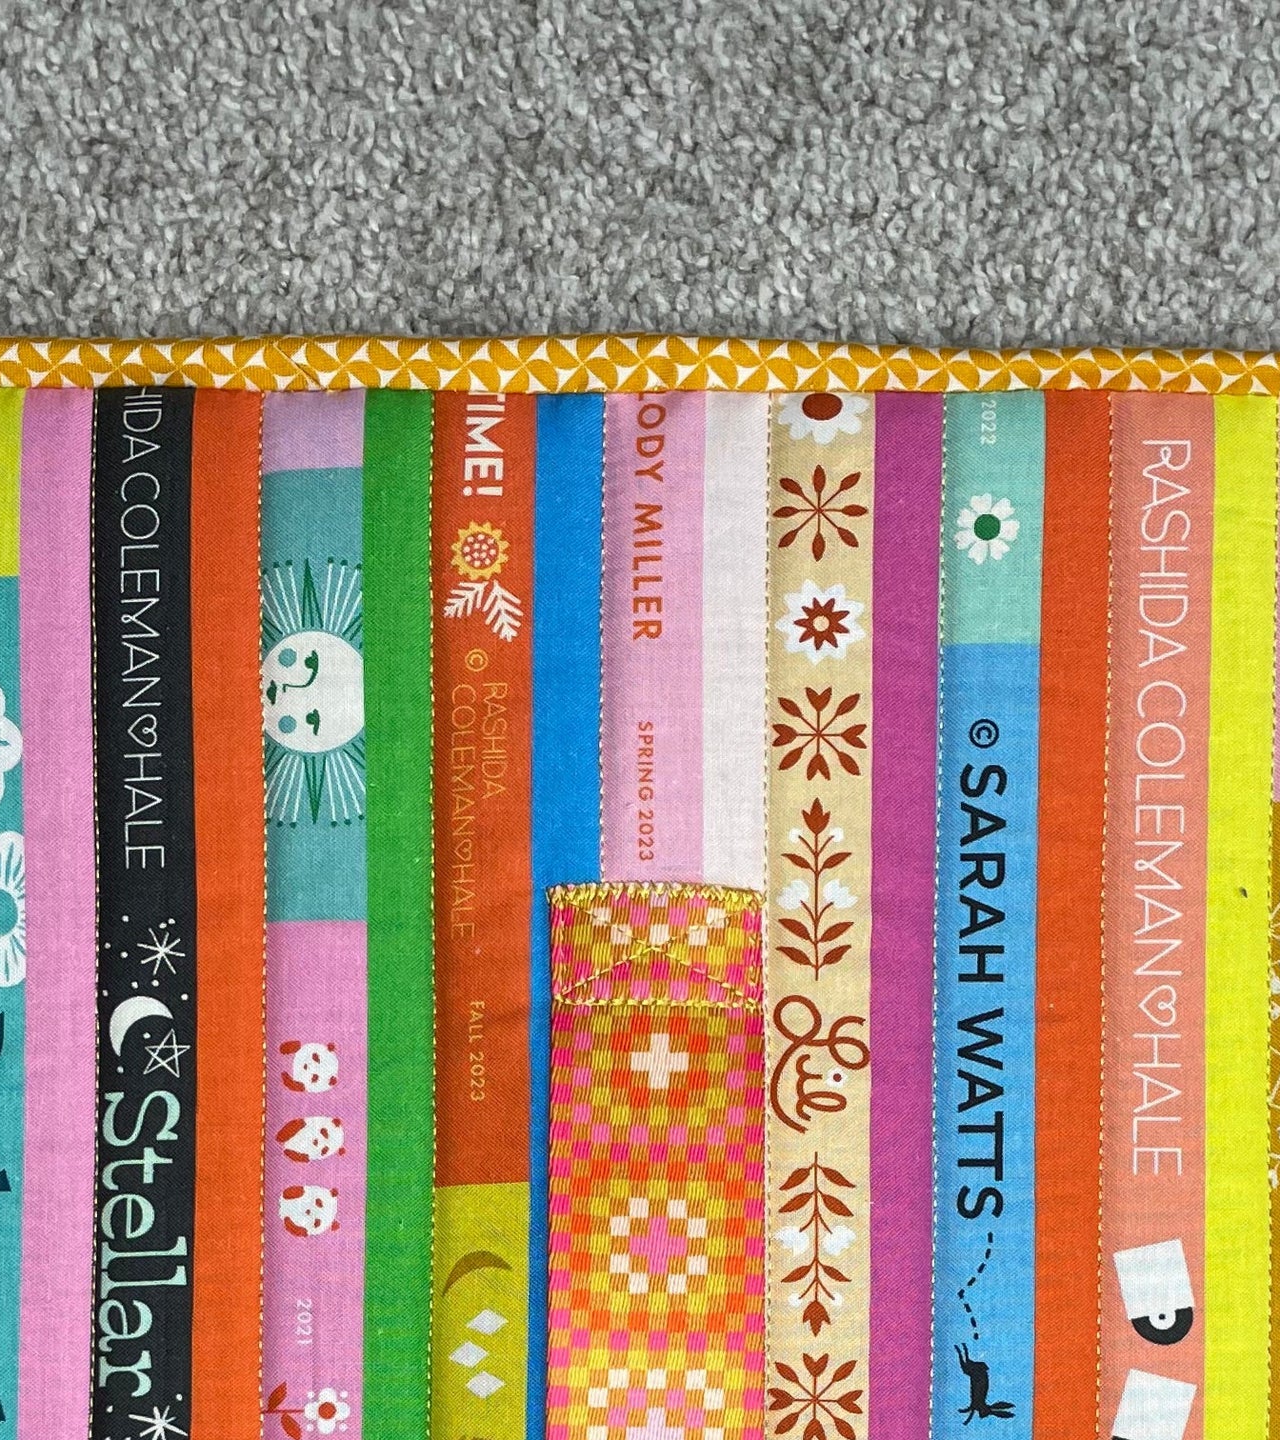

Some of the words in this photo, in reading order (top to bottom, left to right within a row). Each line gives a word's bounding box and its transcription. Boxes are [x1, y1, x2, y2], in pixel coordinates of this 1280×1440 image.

[980, 400, 998, 446] 2022
[631, 503, 664, 642] MILLER
[1139, 438, 1192, 667] RASHIDA
[482, 683, 508, 799] RASHIDA
[636, 721, 654, 800] SPRING
[638, 808, 654, 861] 2023
[468, 1001, 485, 1043] FALL
[771, 995, 871, 1134] Lil
[470, 1052, 485, 1101] 2023
[957, 1008, 1005, 1219] WATTS
[98, 1090, 187, 1398] Stellar
[296, 1298, 313, 1345] 2021
